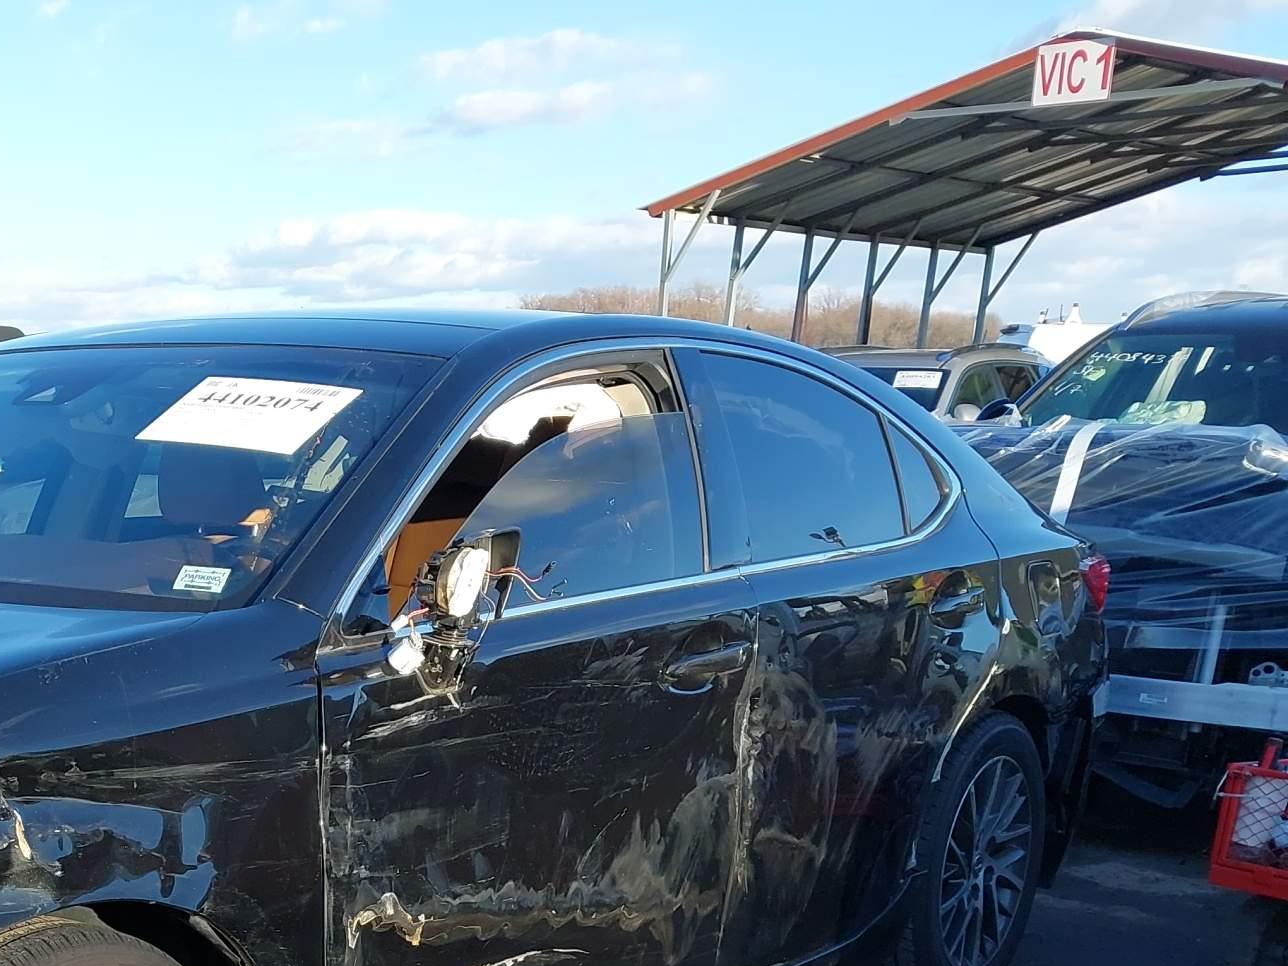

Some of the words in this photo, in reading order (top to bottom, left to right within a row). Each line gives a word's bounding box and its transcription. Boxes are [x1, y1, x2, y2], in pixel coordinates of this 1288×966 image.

[1040, 49, 1088, 96] VIC
[1096, 45, 1113, 90] 1
[197, 391, 325, 412] 44102074
[184, 573, 222, 582] PARKING
